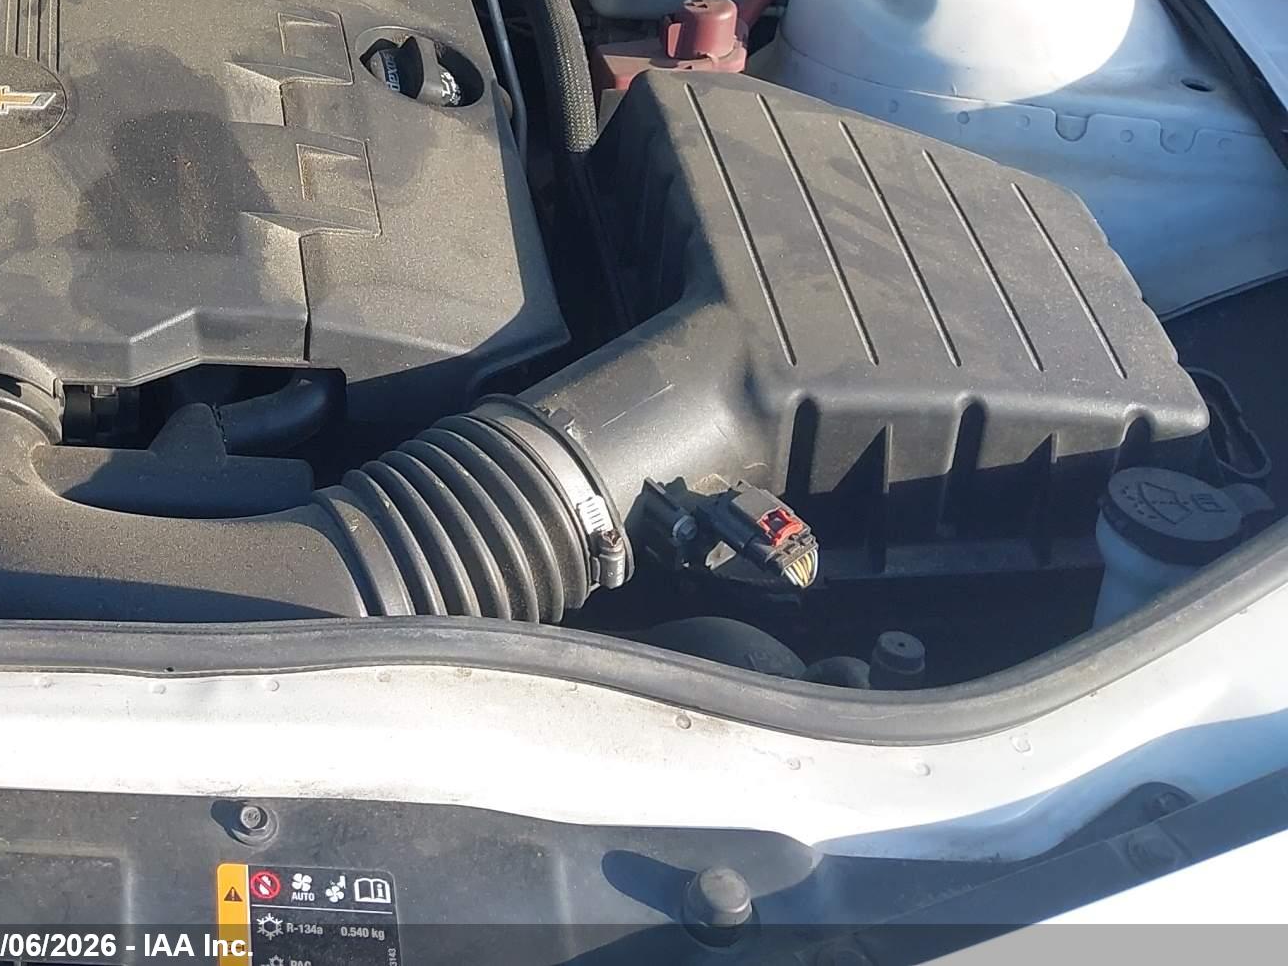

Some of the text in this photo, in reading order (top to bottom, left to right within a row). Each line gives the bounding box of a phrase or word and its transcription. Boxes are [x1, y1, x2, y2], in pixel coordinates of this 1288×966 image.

[291, 892, 315, 902] AUTO
[286, 923, 385, 940] R-134a 0.540 kg
